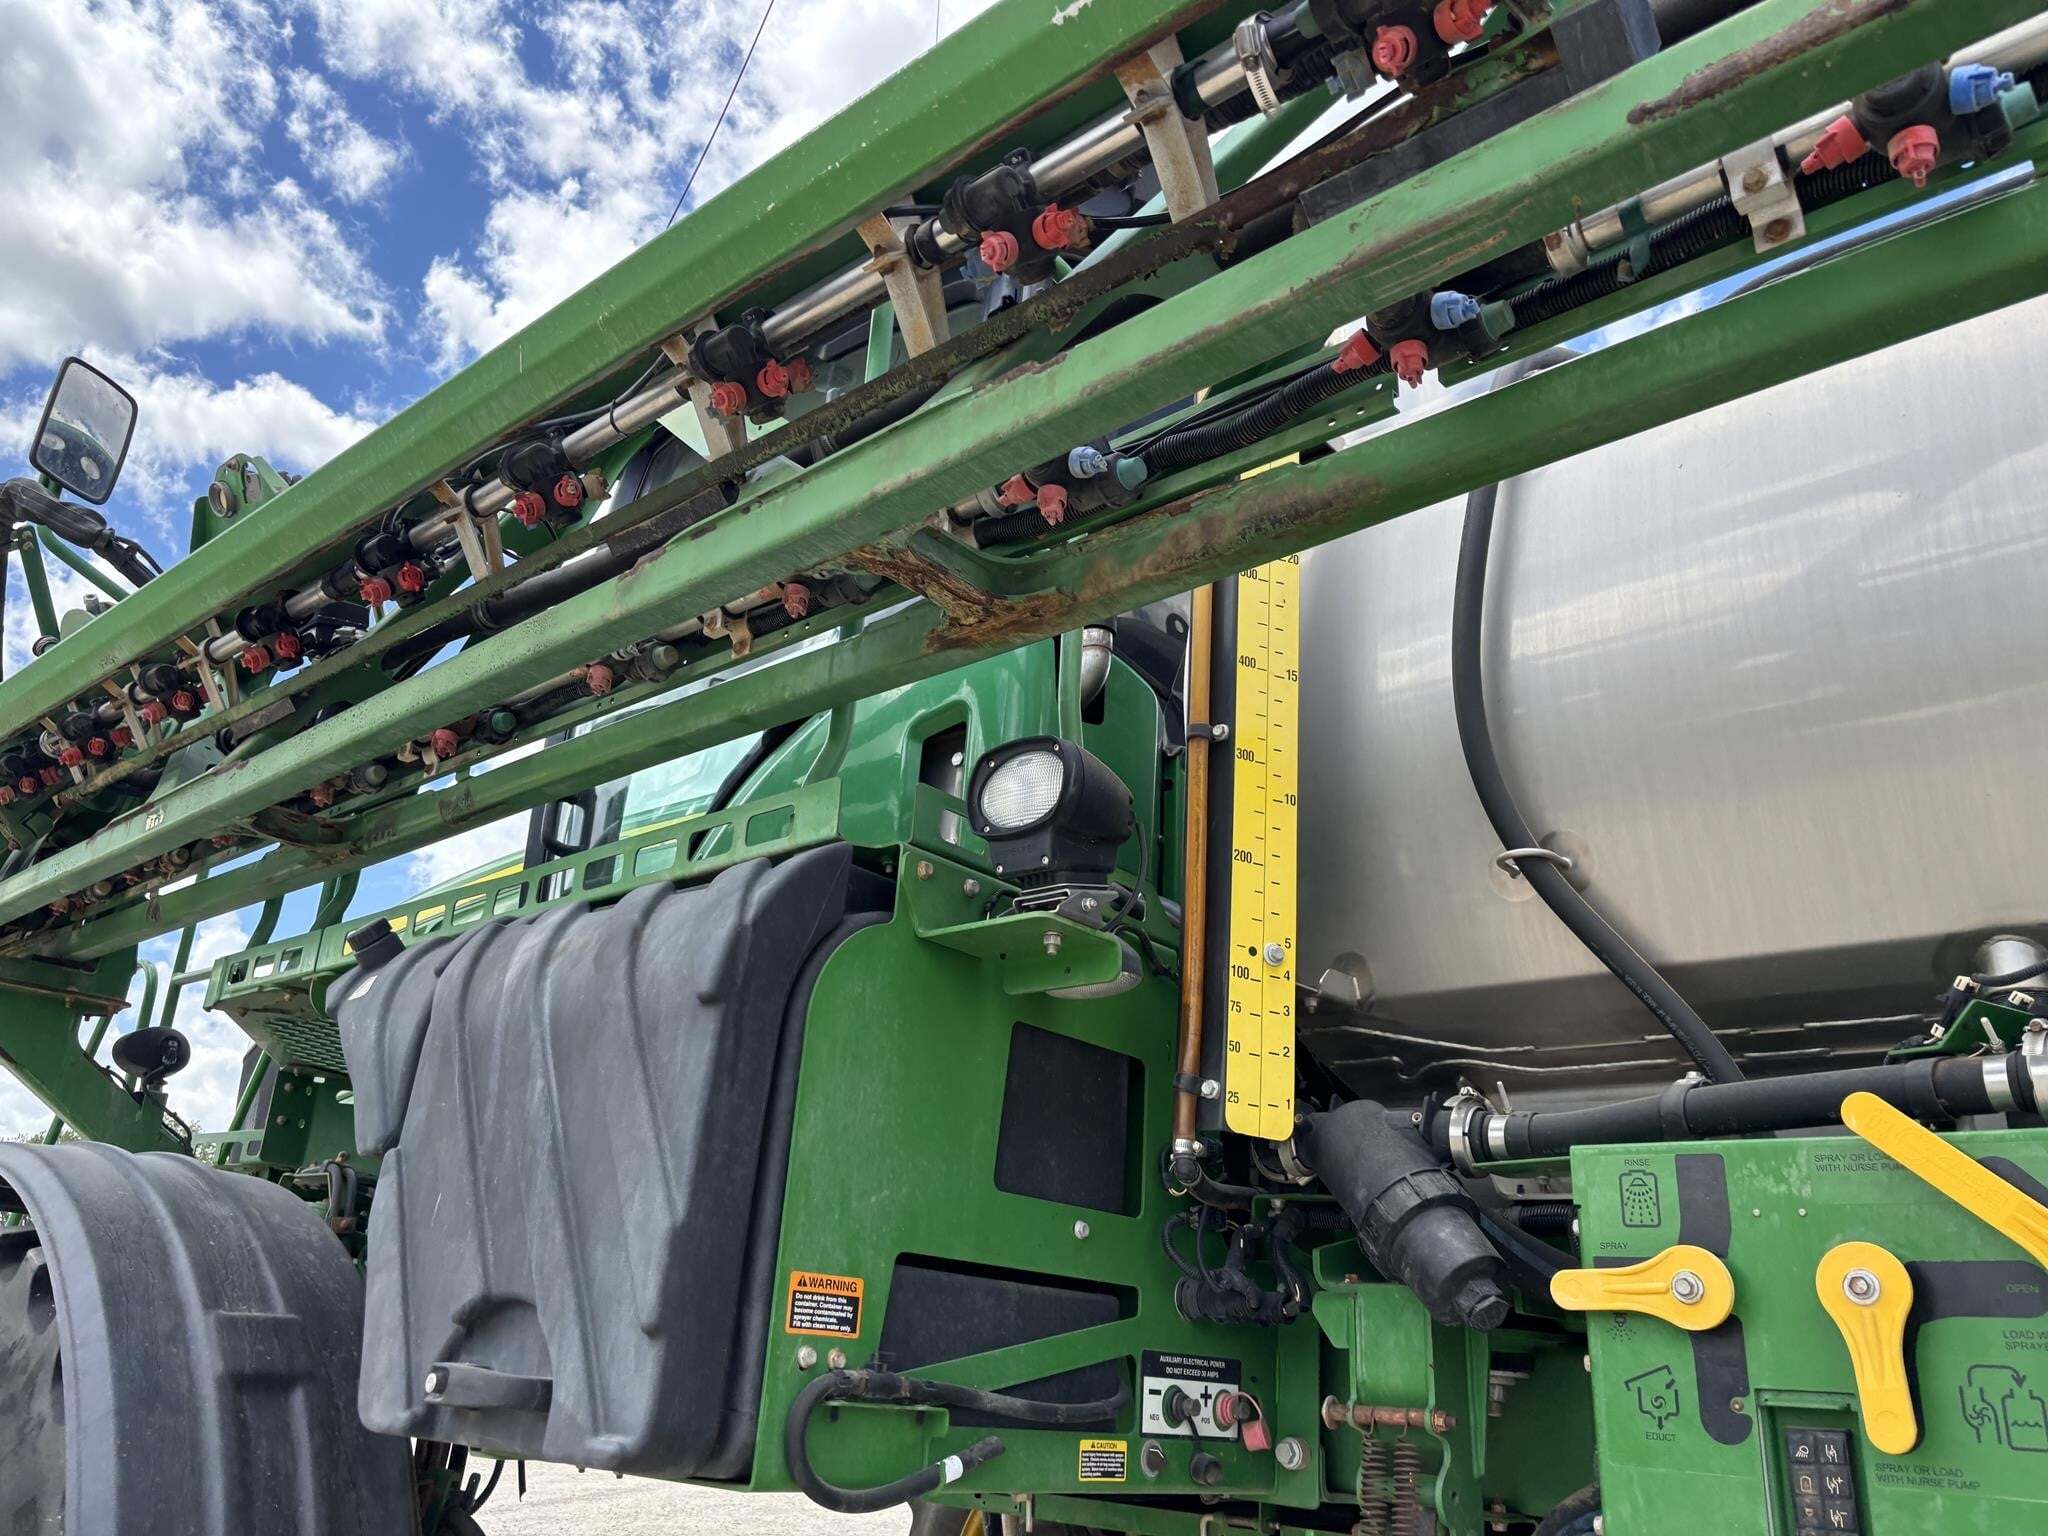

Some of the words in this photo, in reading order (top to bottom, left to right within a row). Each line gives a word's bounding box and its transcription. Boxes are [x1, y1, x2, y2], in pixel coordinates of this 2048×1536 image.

[1288, 554, 1299, 565] 20
[1238, 656, 1256, 669] 400
[1286, 670, 1298, 682] 15
[1236, 749, 1255, 763] 300
[1284, 794, 1296, 806] 10
[1234, 849, 1252, 864] 200
[1284, 938, 1291, 949] 5
[1231, 966, 1250, 980] 100
[1284, 970, 1291, 981] 4
[1230, 1001, 1242, 1013] 75
[1283, 1005, 1290, 1016] 3
[1229, 1041, 1241, 1053] 50
[1283, 1047, 1290, 1058] 2
[1227, 1092, 1239, 1104] 25
[1286, 1099, 1291, 1110] 1
[1624, 1159, 1650, 1167] RINSE
[1814, 1153, 1847, 1162] SPRAY
[1849, 1153, 1865, 1161] OR
[1815, 1163, 1841, 1172] WITH
[1843, 1163, 1879, 1171] NURSE
[1881, 1163, 1901, 1171] PUM
[1600, 1242, 1629, 1250] SPRAY
[809, 1277, 857, 1292] WARNING
[2002, 1329, 2034, 1339] LOAD
[1160, 1355, 1182, 1363] AUXILIARY
[1183, 1357, 1209, 1367] ELECTRICAL
[1210, 1360, 1225, 1369] POWER
[1174, 1367, 1183, 1375] NOT
[1183, 1368, 1200, 1376] EXCEED
[1207, 1370, 1219, 1378] AMPS
[1645, 1431, 1676, 1441] EDUCT
[1096, 1441, 1118, 1450] CAUTION
[1874, 1462, 1910, 1473] SPRAY
[1914, 1465, 1931, 1476] OR
[1933, 1467, 1964, 1478] LOAD
[1876, 1473, 1905, 1484] WITH
[1906, 1476, 1945, 1488] NURSE
[1947, 1480, 1980, 1490] PUMP
